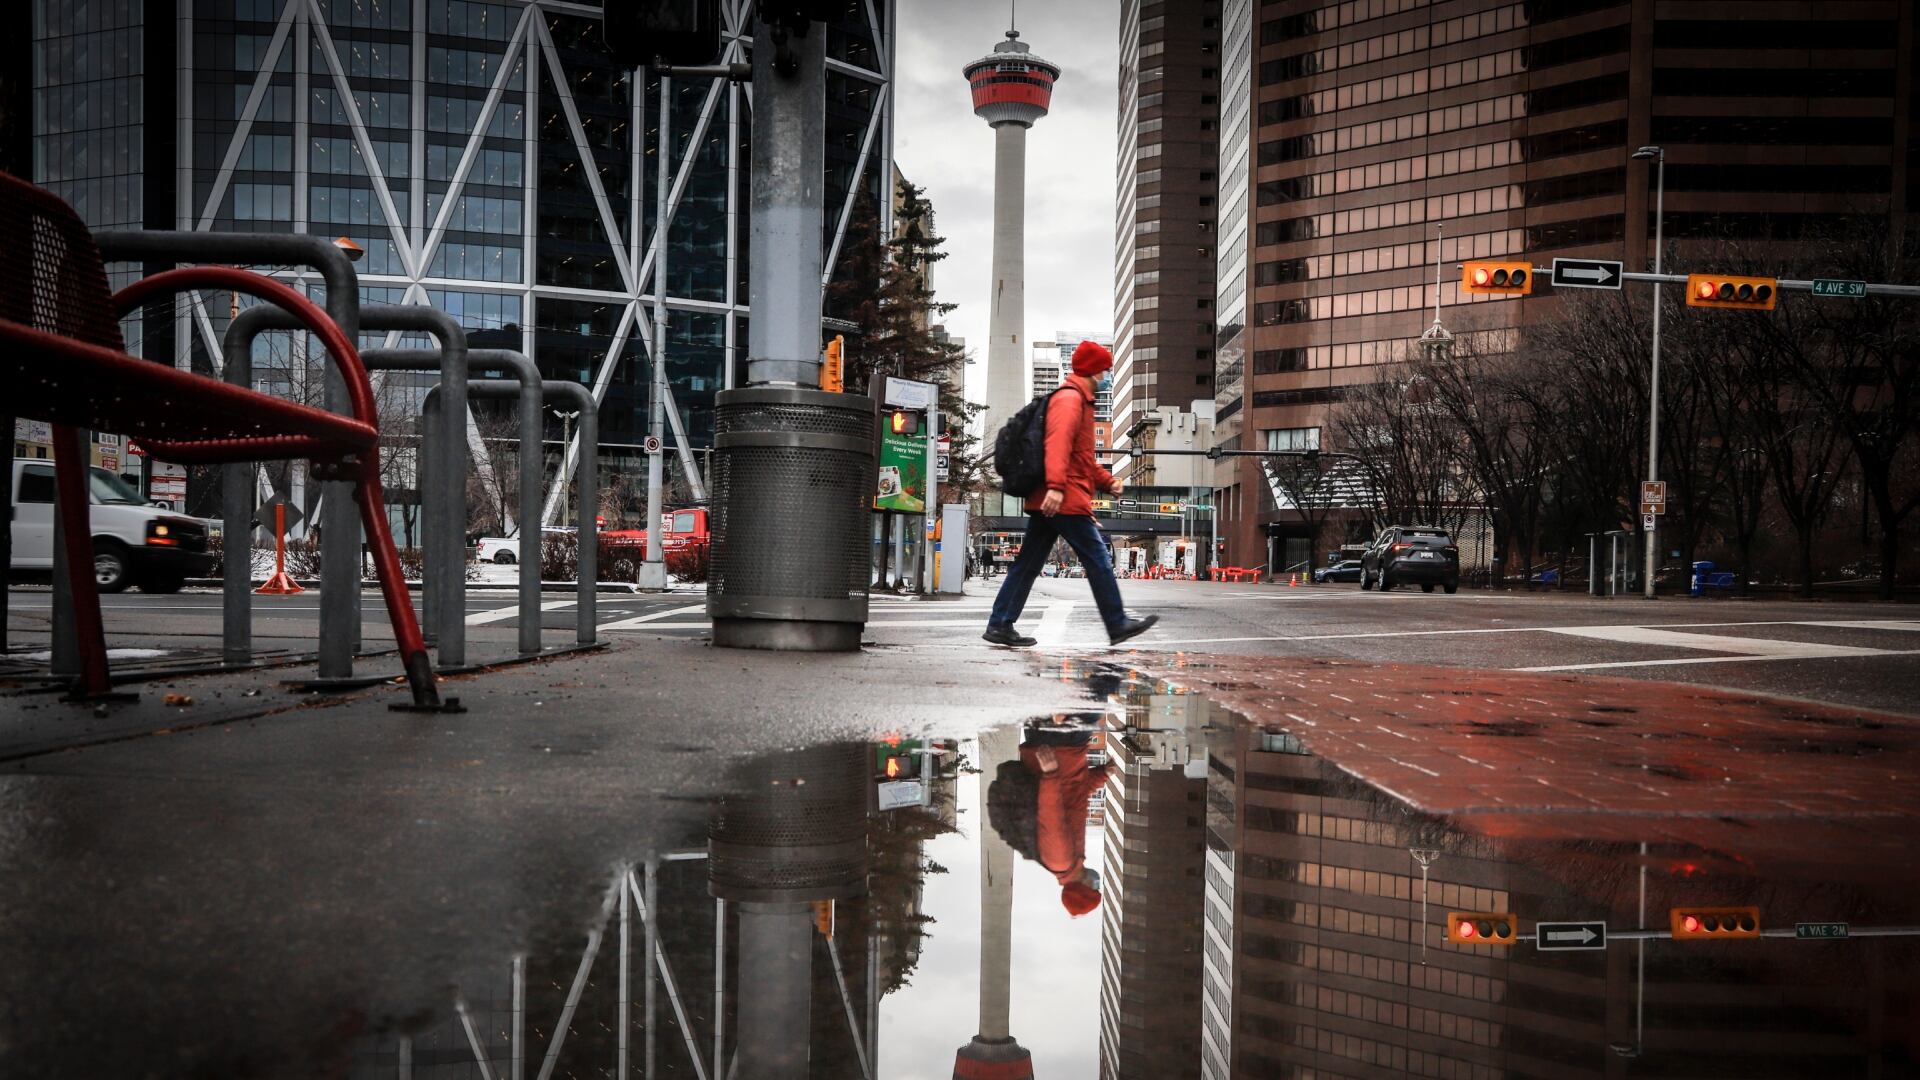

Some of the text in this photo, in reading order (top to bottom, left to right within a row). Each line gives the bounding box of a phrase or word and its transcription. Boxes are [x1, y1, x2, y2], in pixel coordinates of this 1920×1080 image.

[1815, 282, 1864, 294] 4 AVE SW
[893, 446, 906, 454] Every
